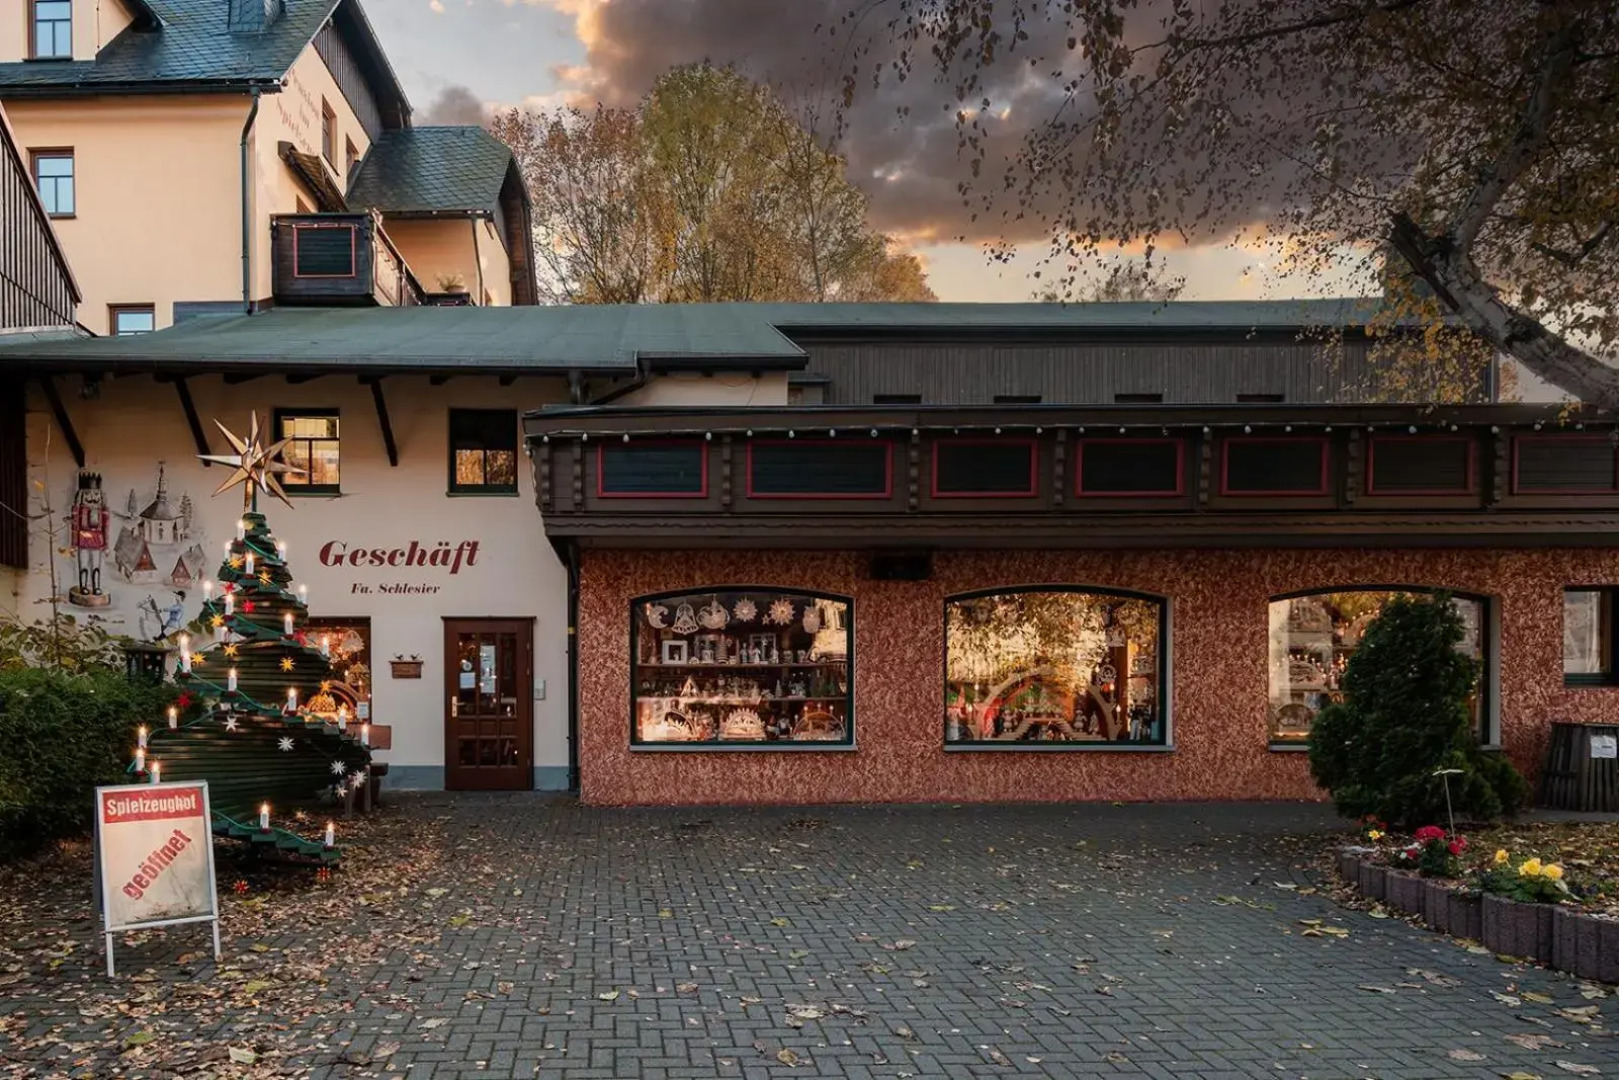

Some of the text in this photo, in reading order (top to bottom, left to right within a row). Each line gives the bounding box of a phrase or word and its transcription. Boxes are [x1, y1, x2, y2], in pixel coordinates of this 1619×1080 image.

[319, 540, 480, 574] Geschäft
[351, 582, 440, 594] Fa. Schlesier
[106, 795, 196, 816] Spielzeughof
[122, 828, 192, 900] geöffnet
